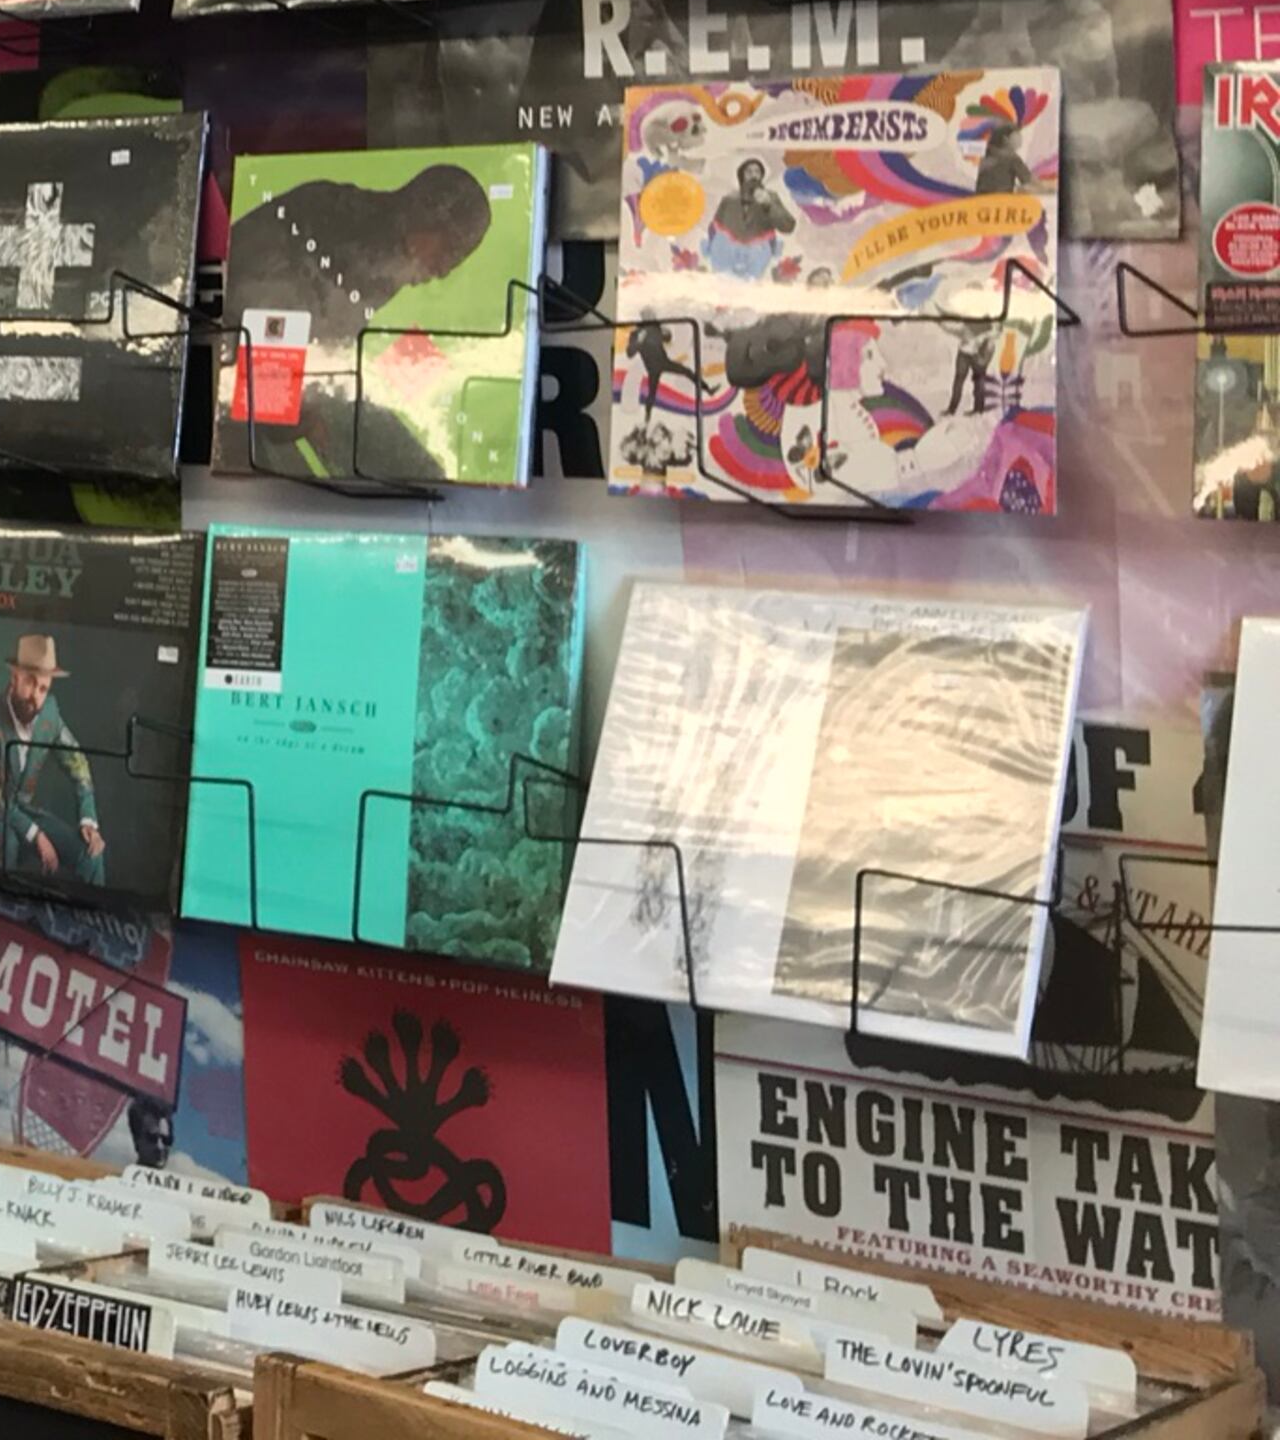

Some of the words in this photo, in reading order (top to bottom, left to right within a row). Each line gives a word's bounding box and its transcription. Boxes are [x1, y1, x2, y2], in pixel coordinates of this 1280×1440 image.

[517, 106, 574, 129] NEW
[885, 224, 911, 248] BE
[916, 210, 969, 237] YOUR
[977, 207, 1033, 228] GIRL
[230, 691, 284, 710] BERT
[296, 695, 378, 718] JANSCH
[254, 948, 349, 976] CHAINSAW
[494, 987, 583, 1009] HEINESS
[757, 1071, 1029, 1183] ENGINE
[1060, 1123, 1219, 1215] TAK
[6, 1201, 56, 1228] KNACK
[751, 1139, 842, 1218] TO
[873, 1162, 1026, 1254] THE
[1055, 1196, 1220, 1290] WAT
[166, 1244, 210, 1267] JERRY
[250, 1242, 301, 1263] Gordon
[517, 1258, 561, 1279] RIVER
[837, 1225, 972, 1268] FEATURING
[981, 1254, 996, 1271] A
[1007, 1259, 1159, 1304] SEAWORTHY
[648, 1291, 698, 1322] NICK
[712, 1302, 782, 1342] LOWE
[583, 1329, 696, 1377] LOVERBOY
[973, 1328, 1066, 1372] LYRES
[490, 1356, 568, 1388] LOGGINS
[577, 1378, 616, 1402] AND
[624, 1392, 701, 1428] MESSINA
[836, 1337, 880, 1367] THE
[953, 1365, 1056, 1408] SPOONFUL
[767, 1389, 811, 1418] LOVE
[815, 1405, 854, 1429] AND
